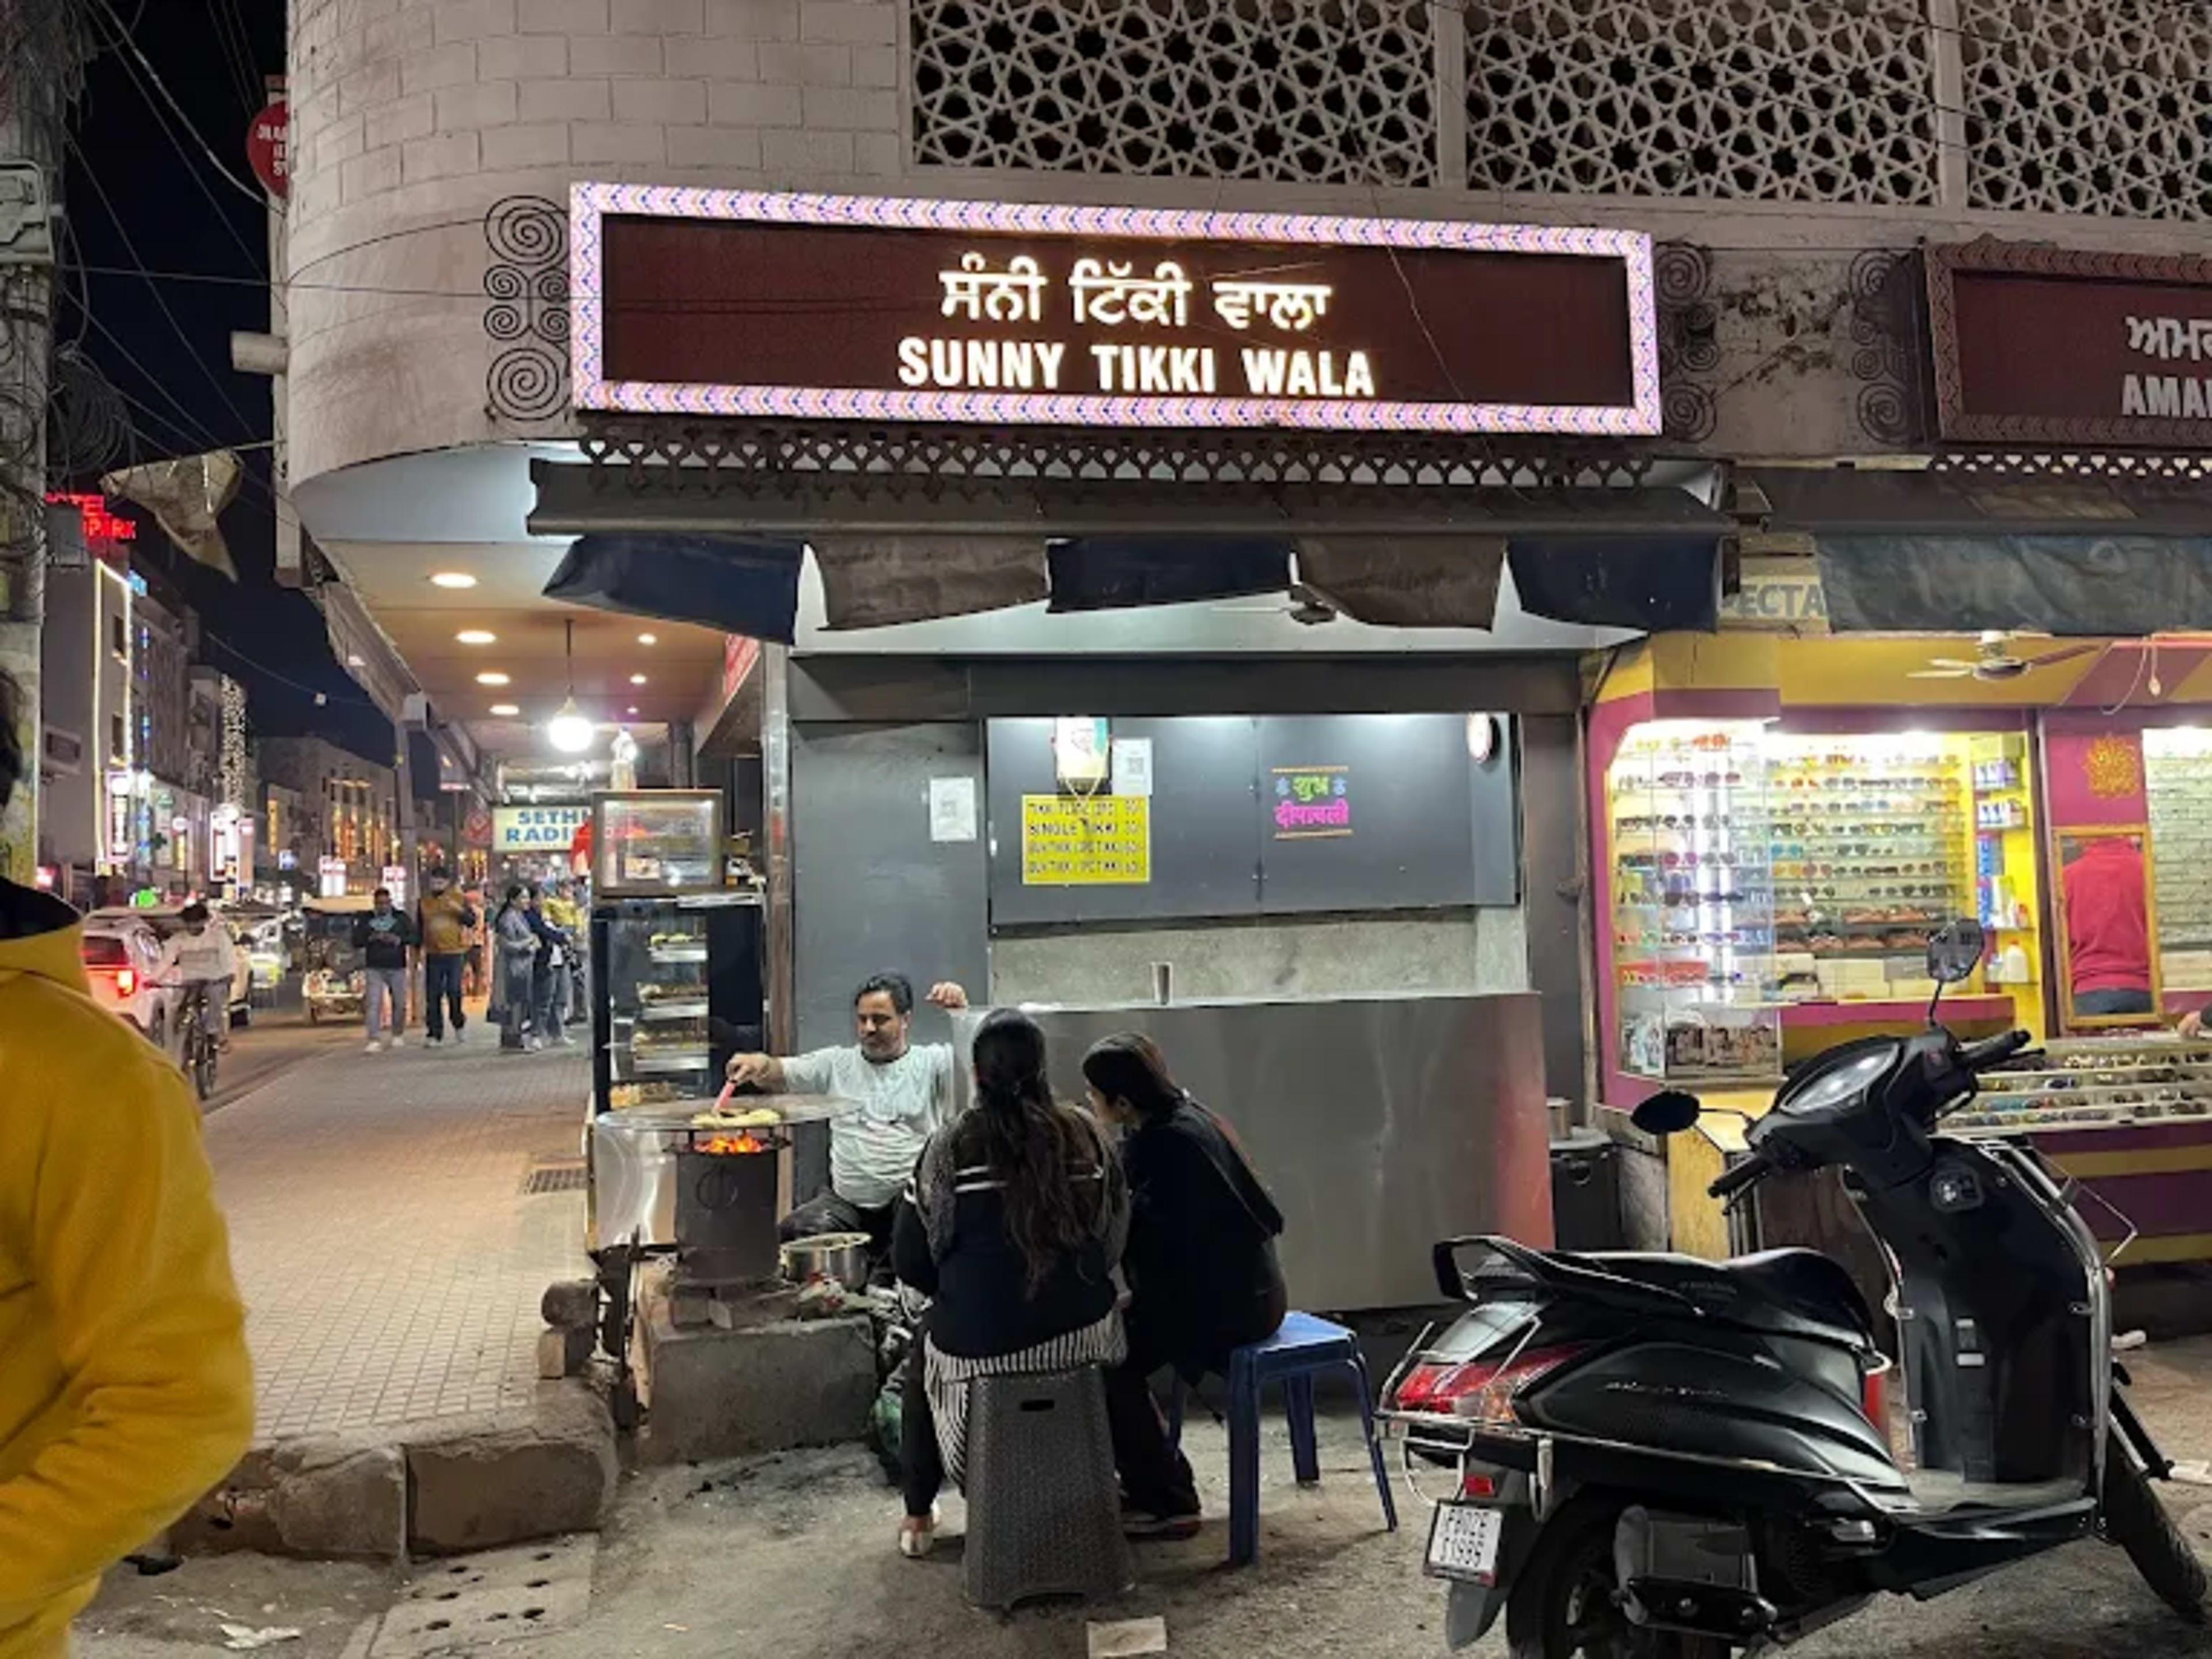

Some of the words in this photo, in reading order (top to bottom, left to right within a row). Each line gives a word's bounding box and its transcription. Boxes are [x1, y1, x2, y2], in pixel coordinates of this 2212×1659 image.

[938, 251, 1047, 321] ਸੰਨੀ
[1069, 258, 1191, 327] ਟਿੱਕੀ
[1213, 280, 1332, 330] ਵਾਲਾ
[898, 338, 1065, 389] SUNNY
[1091, 344, 1215, 393] TIKKI
[1242, 350, 1375, 396] WALA
[506, 827, 570, 842] RADI
